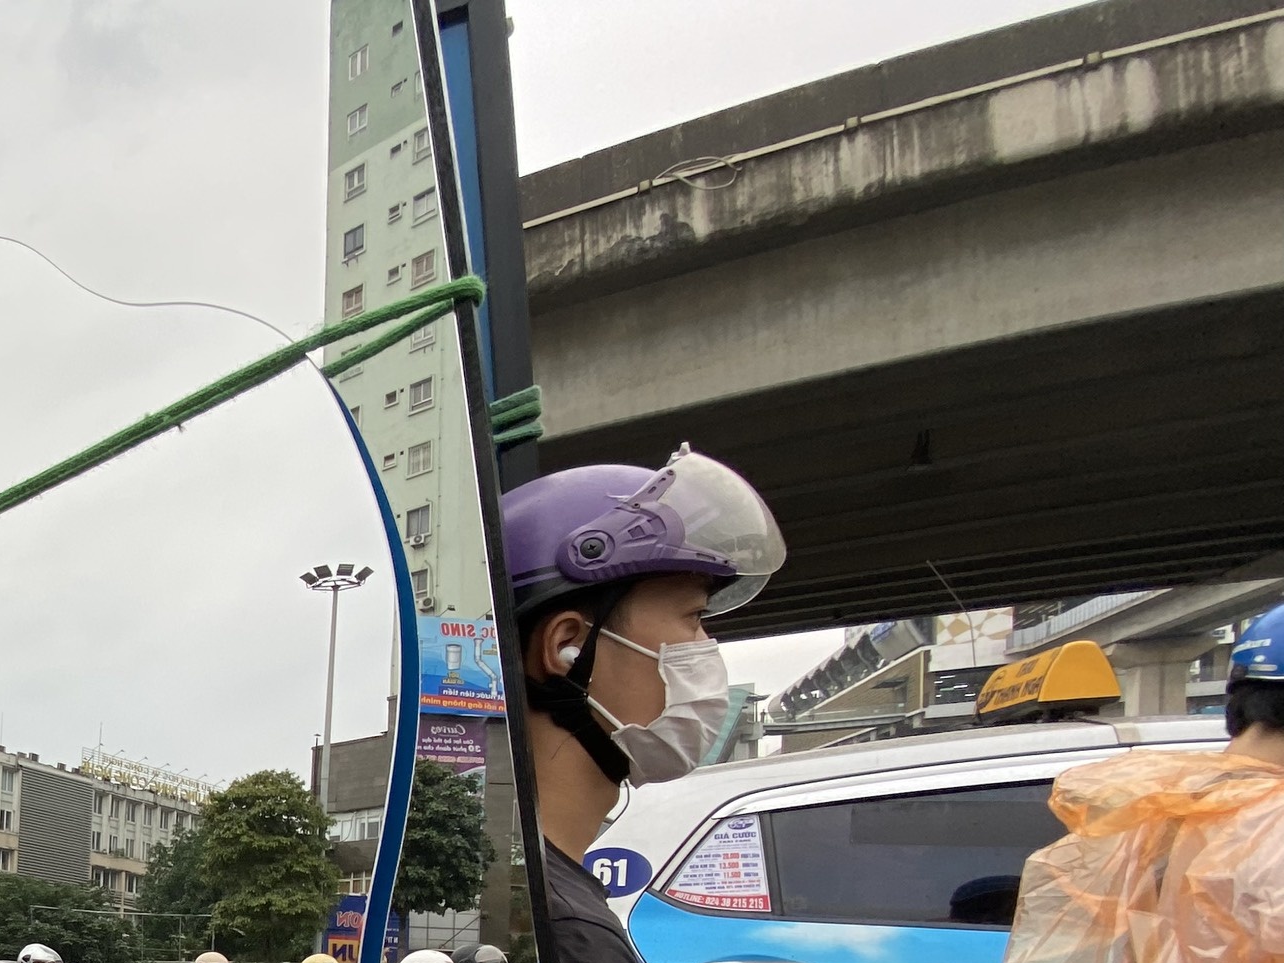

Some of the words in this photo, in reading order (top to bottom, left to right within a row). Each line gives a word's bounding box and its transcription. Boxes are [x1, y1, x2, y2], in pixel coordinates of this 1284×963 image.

[593, 858, 627, 887] 61
[674, 892, 705, 903] HOTLINE:
[705, 897, 719, 906] 024
[732, 898, 747, 908] 215
